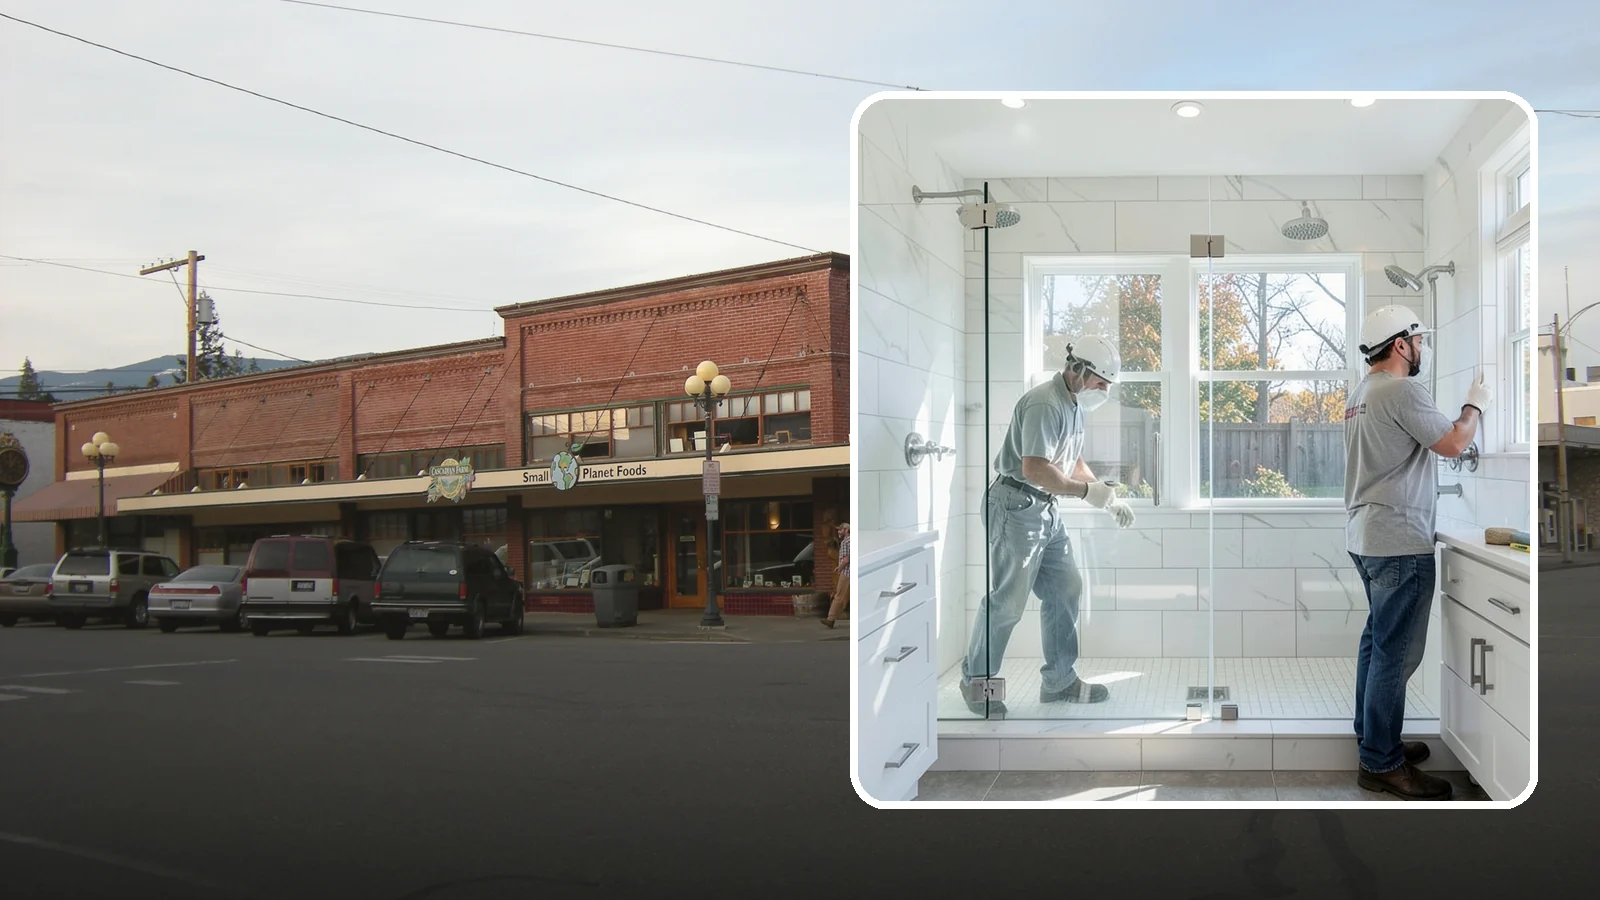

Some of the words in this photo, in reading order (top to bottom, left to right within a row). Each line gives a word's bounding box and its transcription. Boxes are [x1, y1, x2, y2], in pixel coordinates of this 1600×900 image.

[523, 471, 549, 483] Small
[582, 468, 614, 479] Planet
[616, 465, 647, 477] Foods
